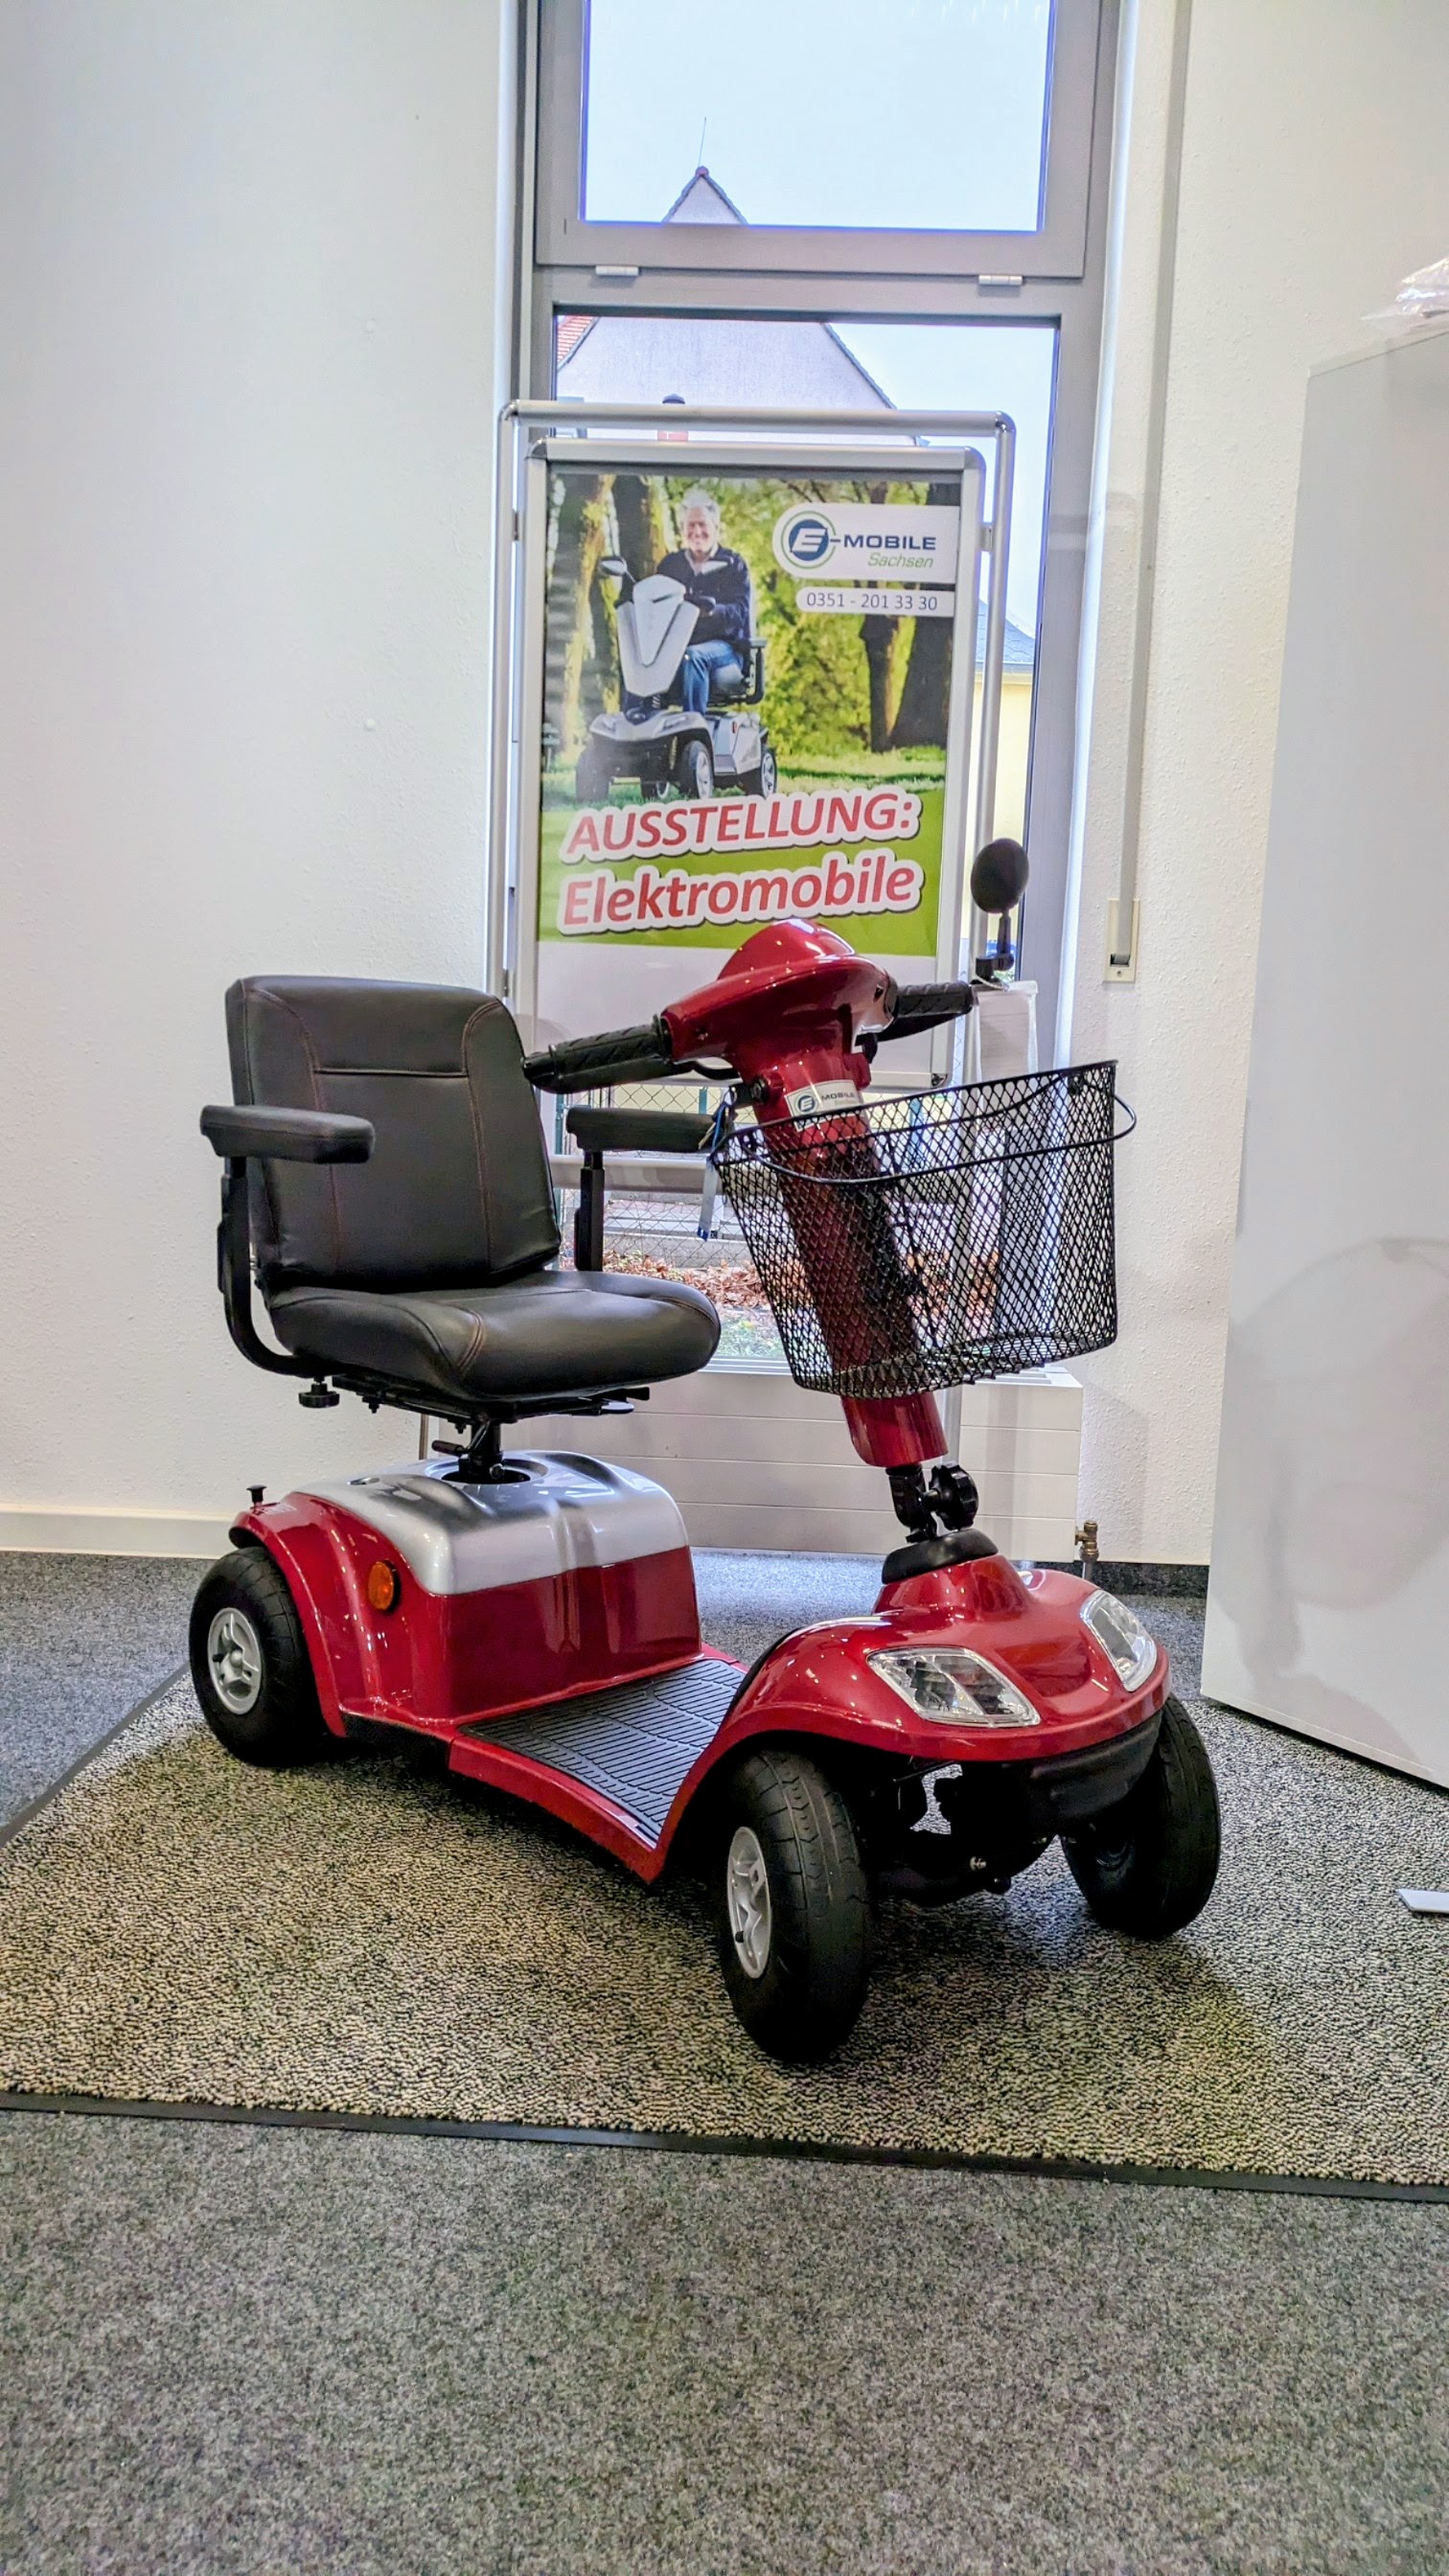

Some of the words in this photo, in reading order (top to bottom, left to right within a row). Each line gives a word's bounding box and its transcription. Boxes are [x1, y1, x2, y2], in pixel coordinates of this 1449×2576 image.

[867, 552, 933, 568] Sachsen
[807, 592, 844, 608] 0351
[862, 593, 888, 609] 201
[894, 596, 912, 610] 33
[918, 596, 938, 610] 30
[566, 793, 912, 855] AUSSTELLUNG:
[563, 855, 915, 926] Elektromobile
